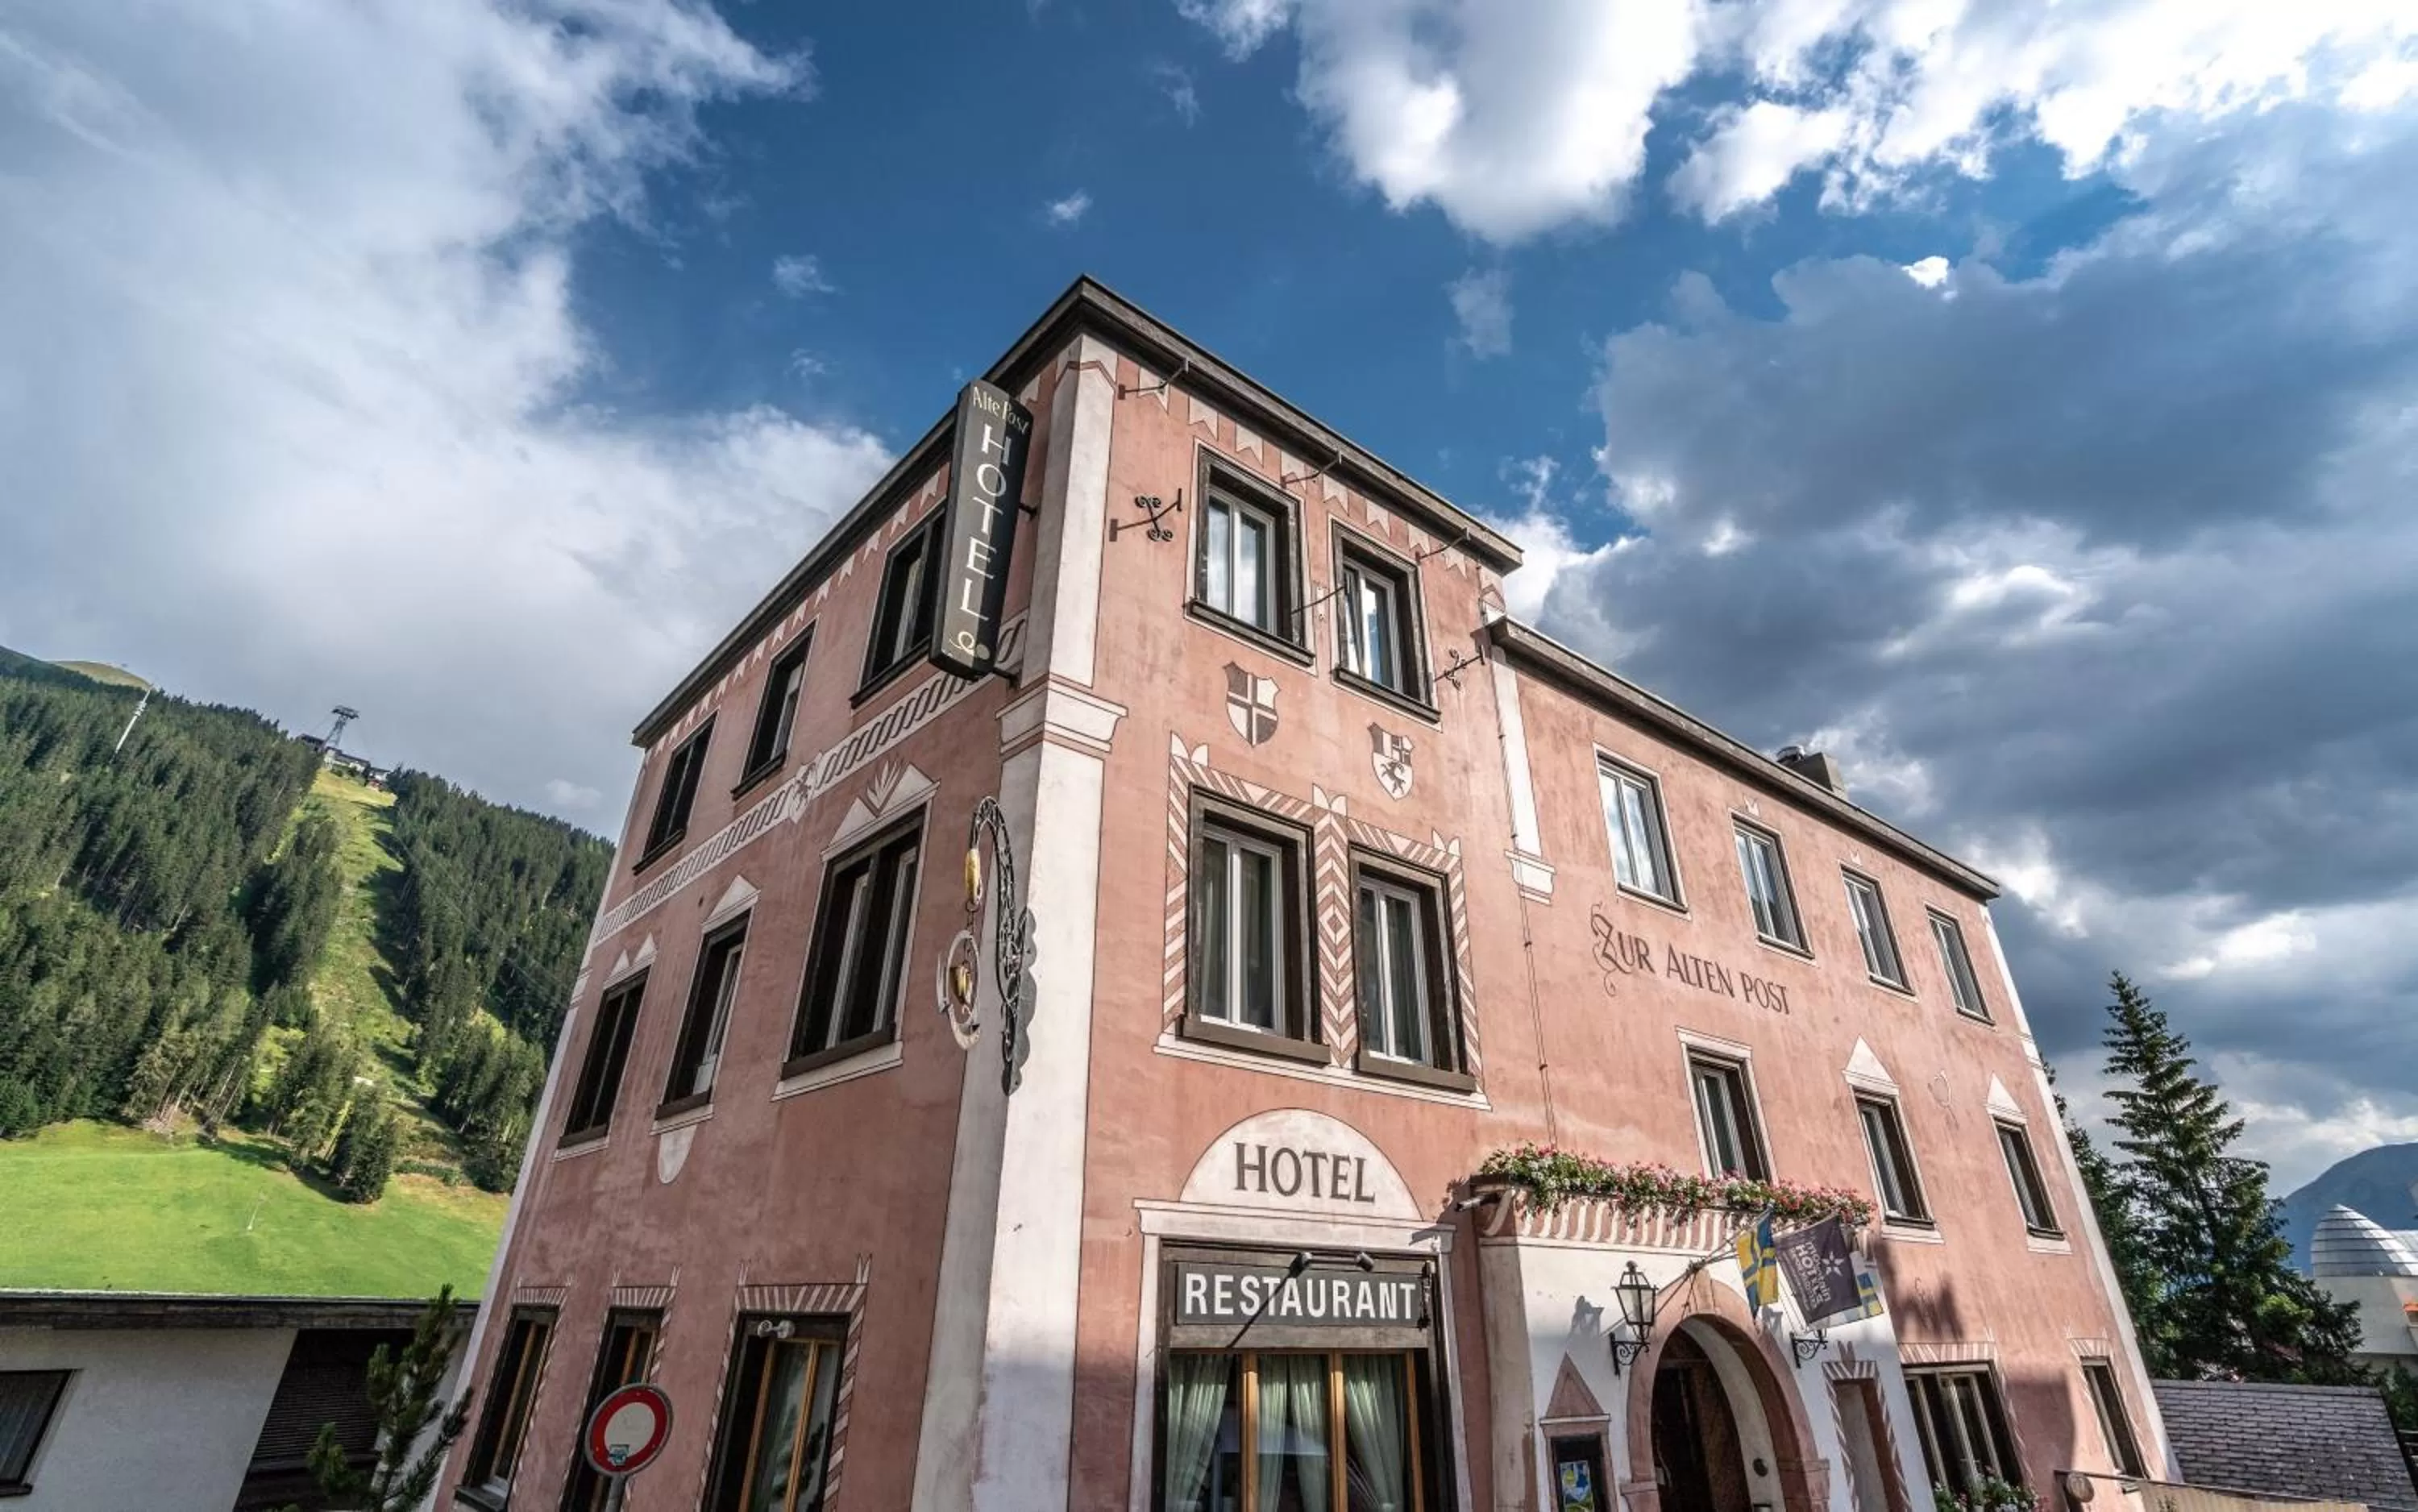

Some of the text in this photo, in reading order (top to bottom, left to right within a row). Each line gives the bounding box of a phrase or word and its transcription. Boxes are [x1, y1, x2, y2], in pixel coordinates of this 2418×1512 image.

[973, 386, 1029, 434] Alte Post
[960, 423, 1012, 621] HOTEL
[1590, 902, 1790, 1015] ZUR ALTEN POST
[1234, 1141, 1376, 1203] HOTEL
[1185, 1273, 1416, 1320] RESTAURANT
